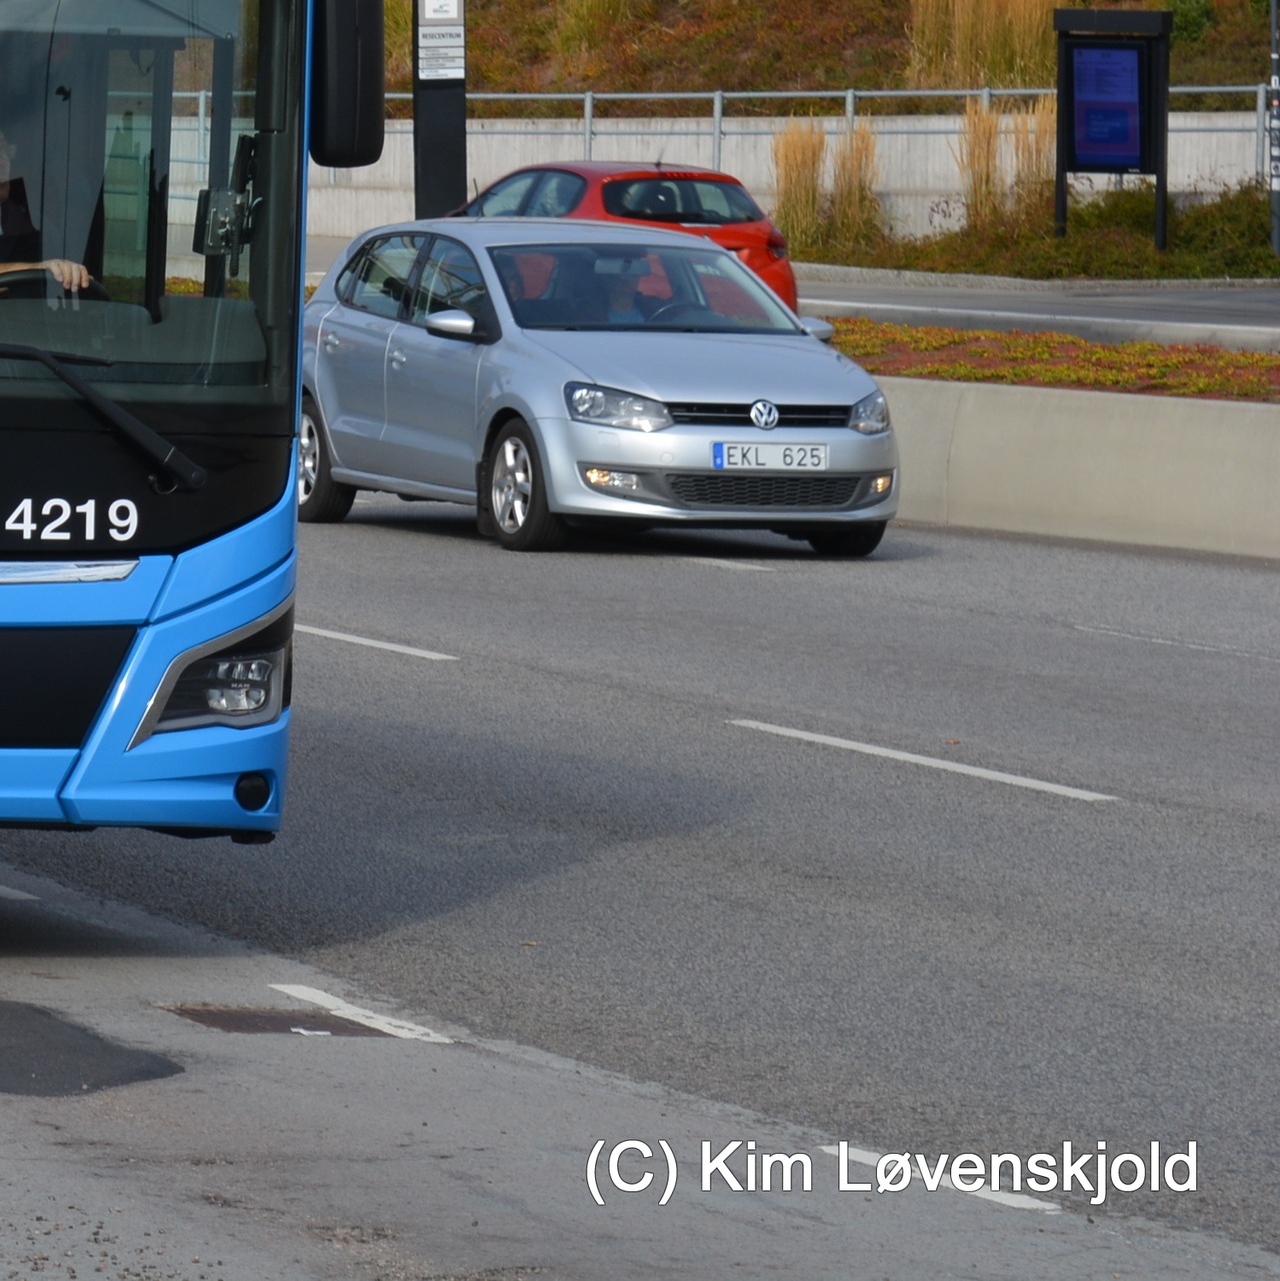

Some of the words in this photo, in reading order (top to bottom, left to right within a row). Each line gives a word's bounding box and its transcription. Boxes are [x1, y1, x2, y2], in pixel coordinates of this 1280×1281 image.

[727, 446, 766, 466] EKL
[783, 447, 822, 467] 625
[5, 498, 138, 541] 4219
